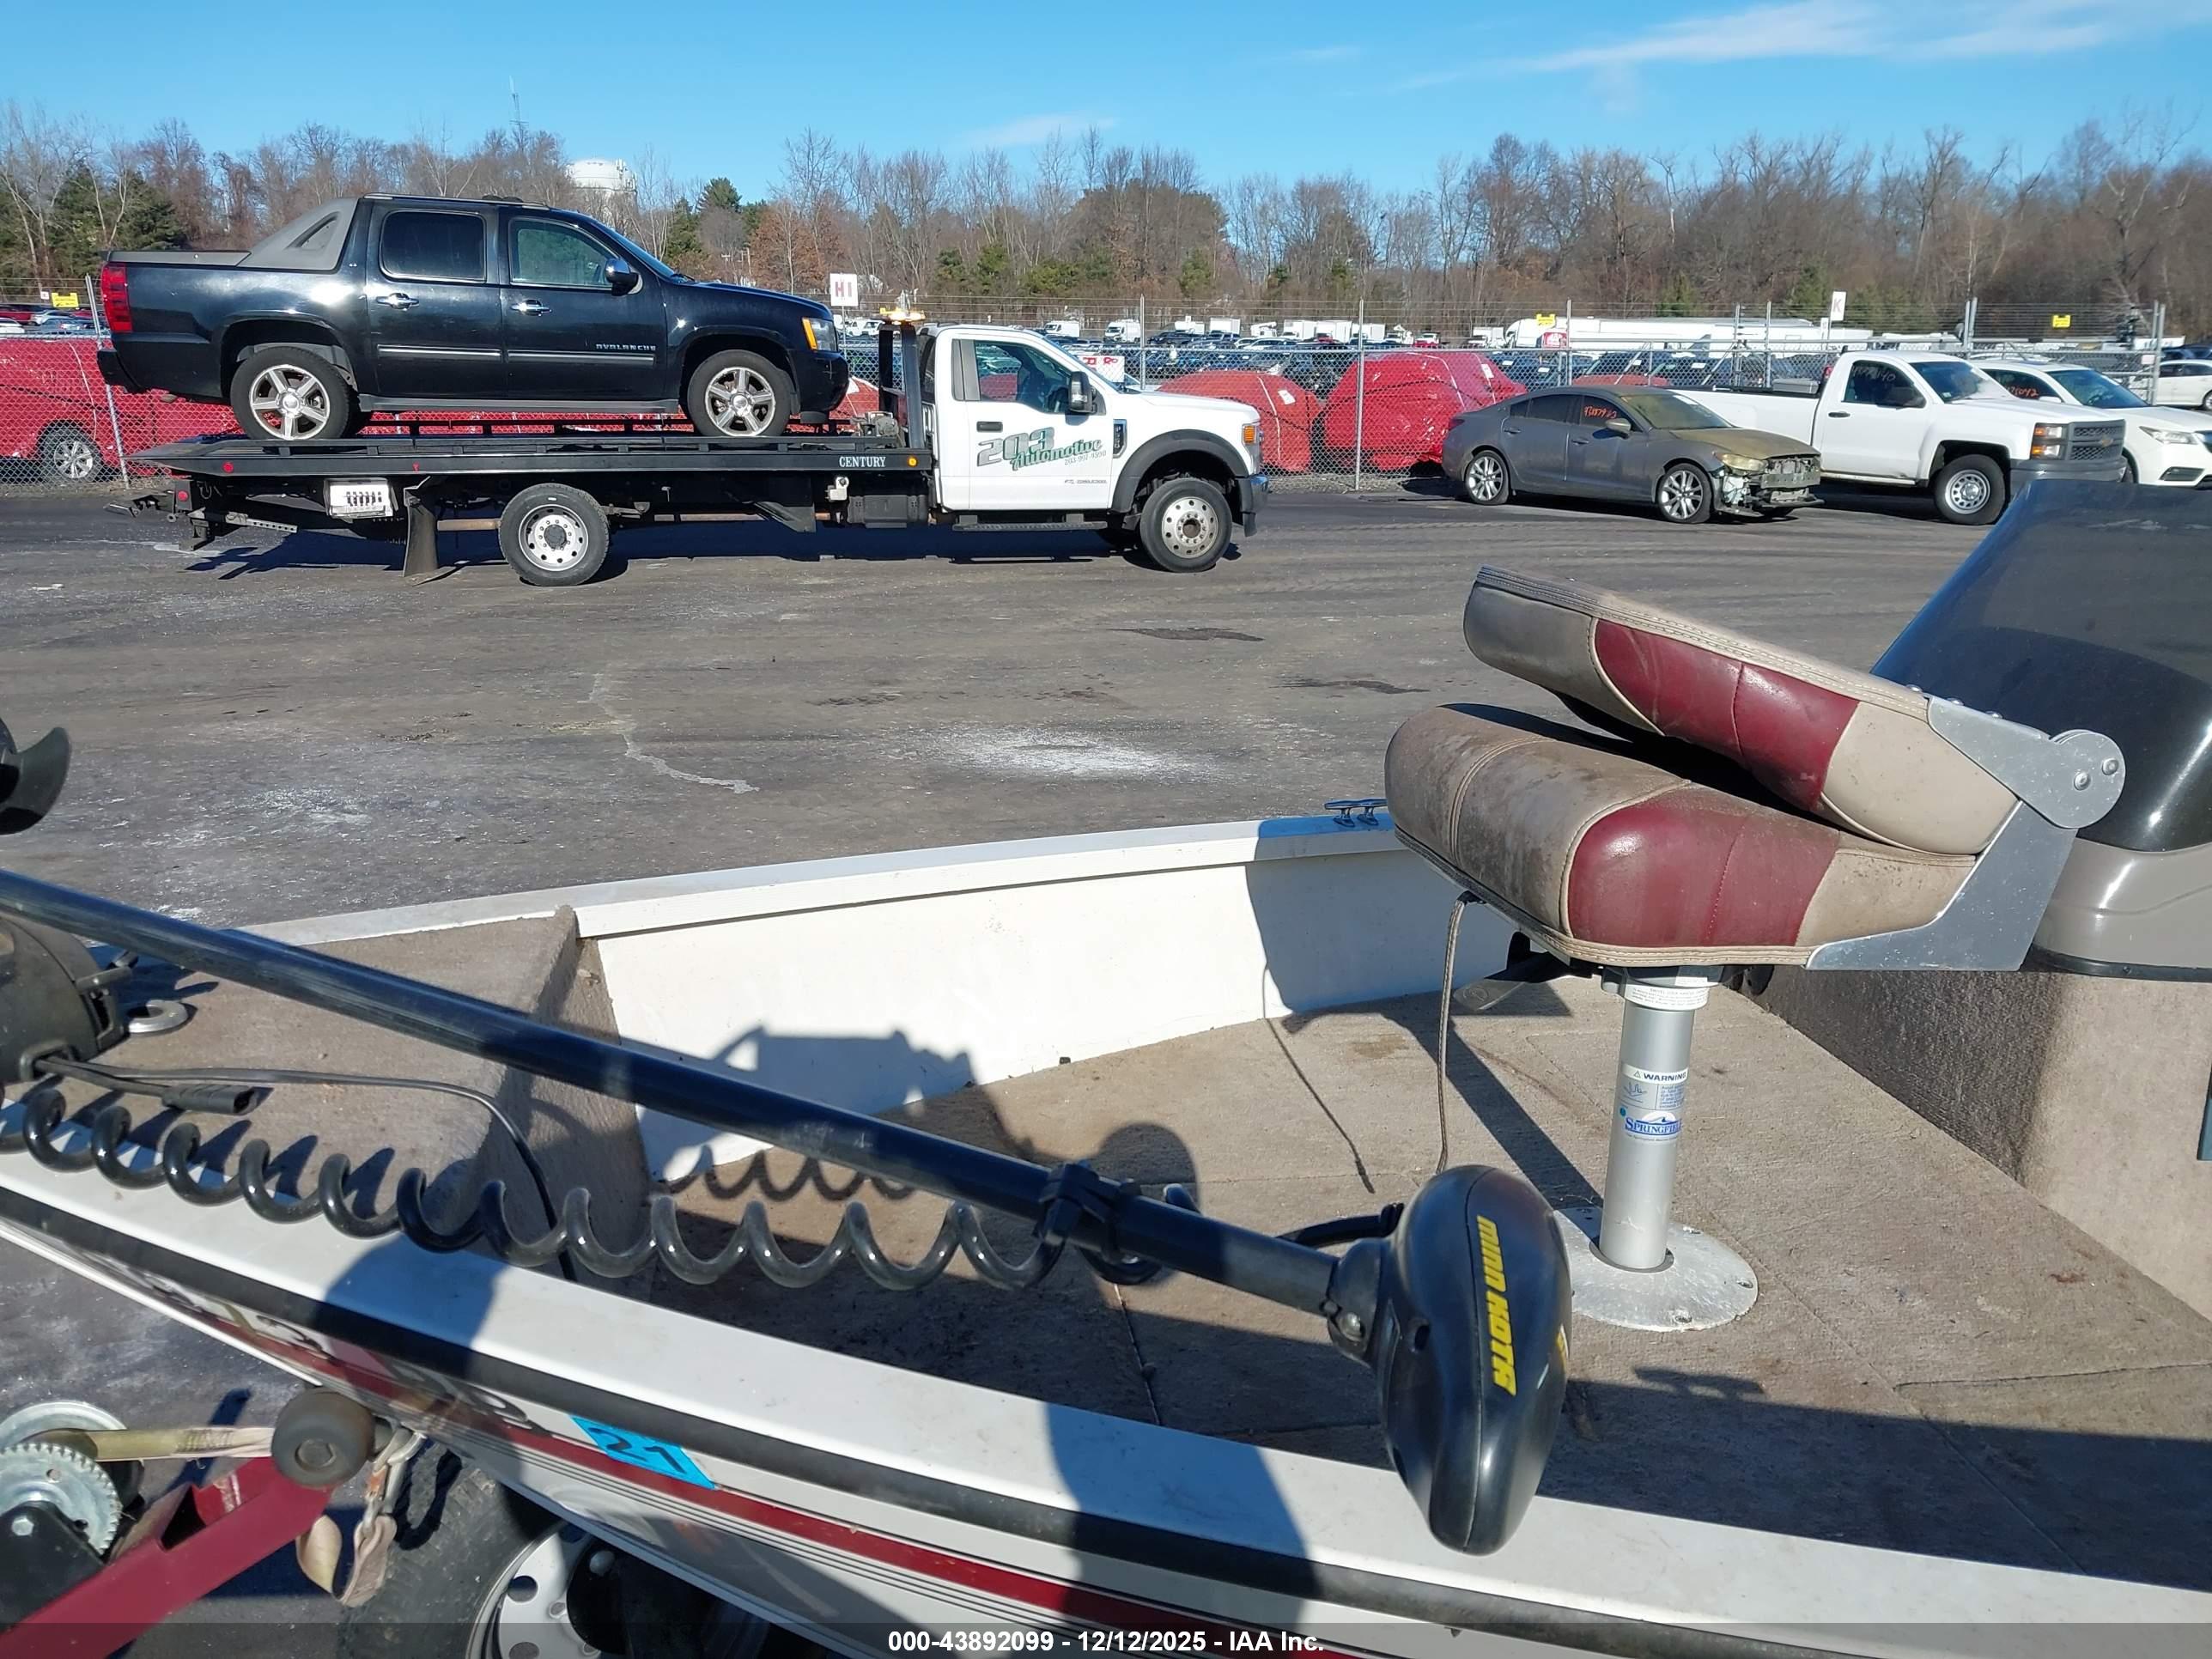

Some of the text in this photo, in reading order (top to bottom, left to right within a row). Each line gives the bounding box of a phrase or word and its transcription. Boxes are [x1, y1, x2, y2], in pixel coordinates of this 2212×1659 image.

[839, 456, 886, 468] CENTURY
[976, 427, 1054, 466] 203
[1010, 439, 1103, 471] Automotive
[1477, 1214, 1517, 1395] MINN KOTA
